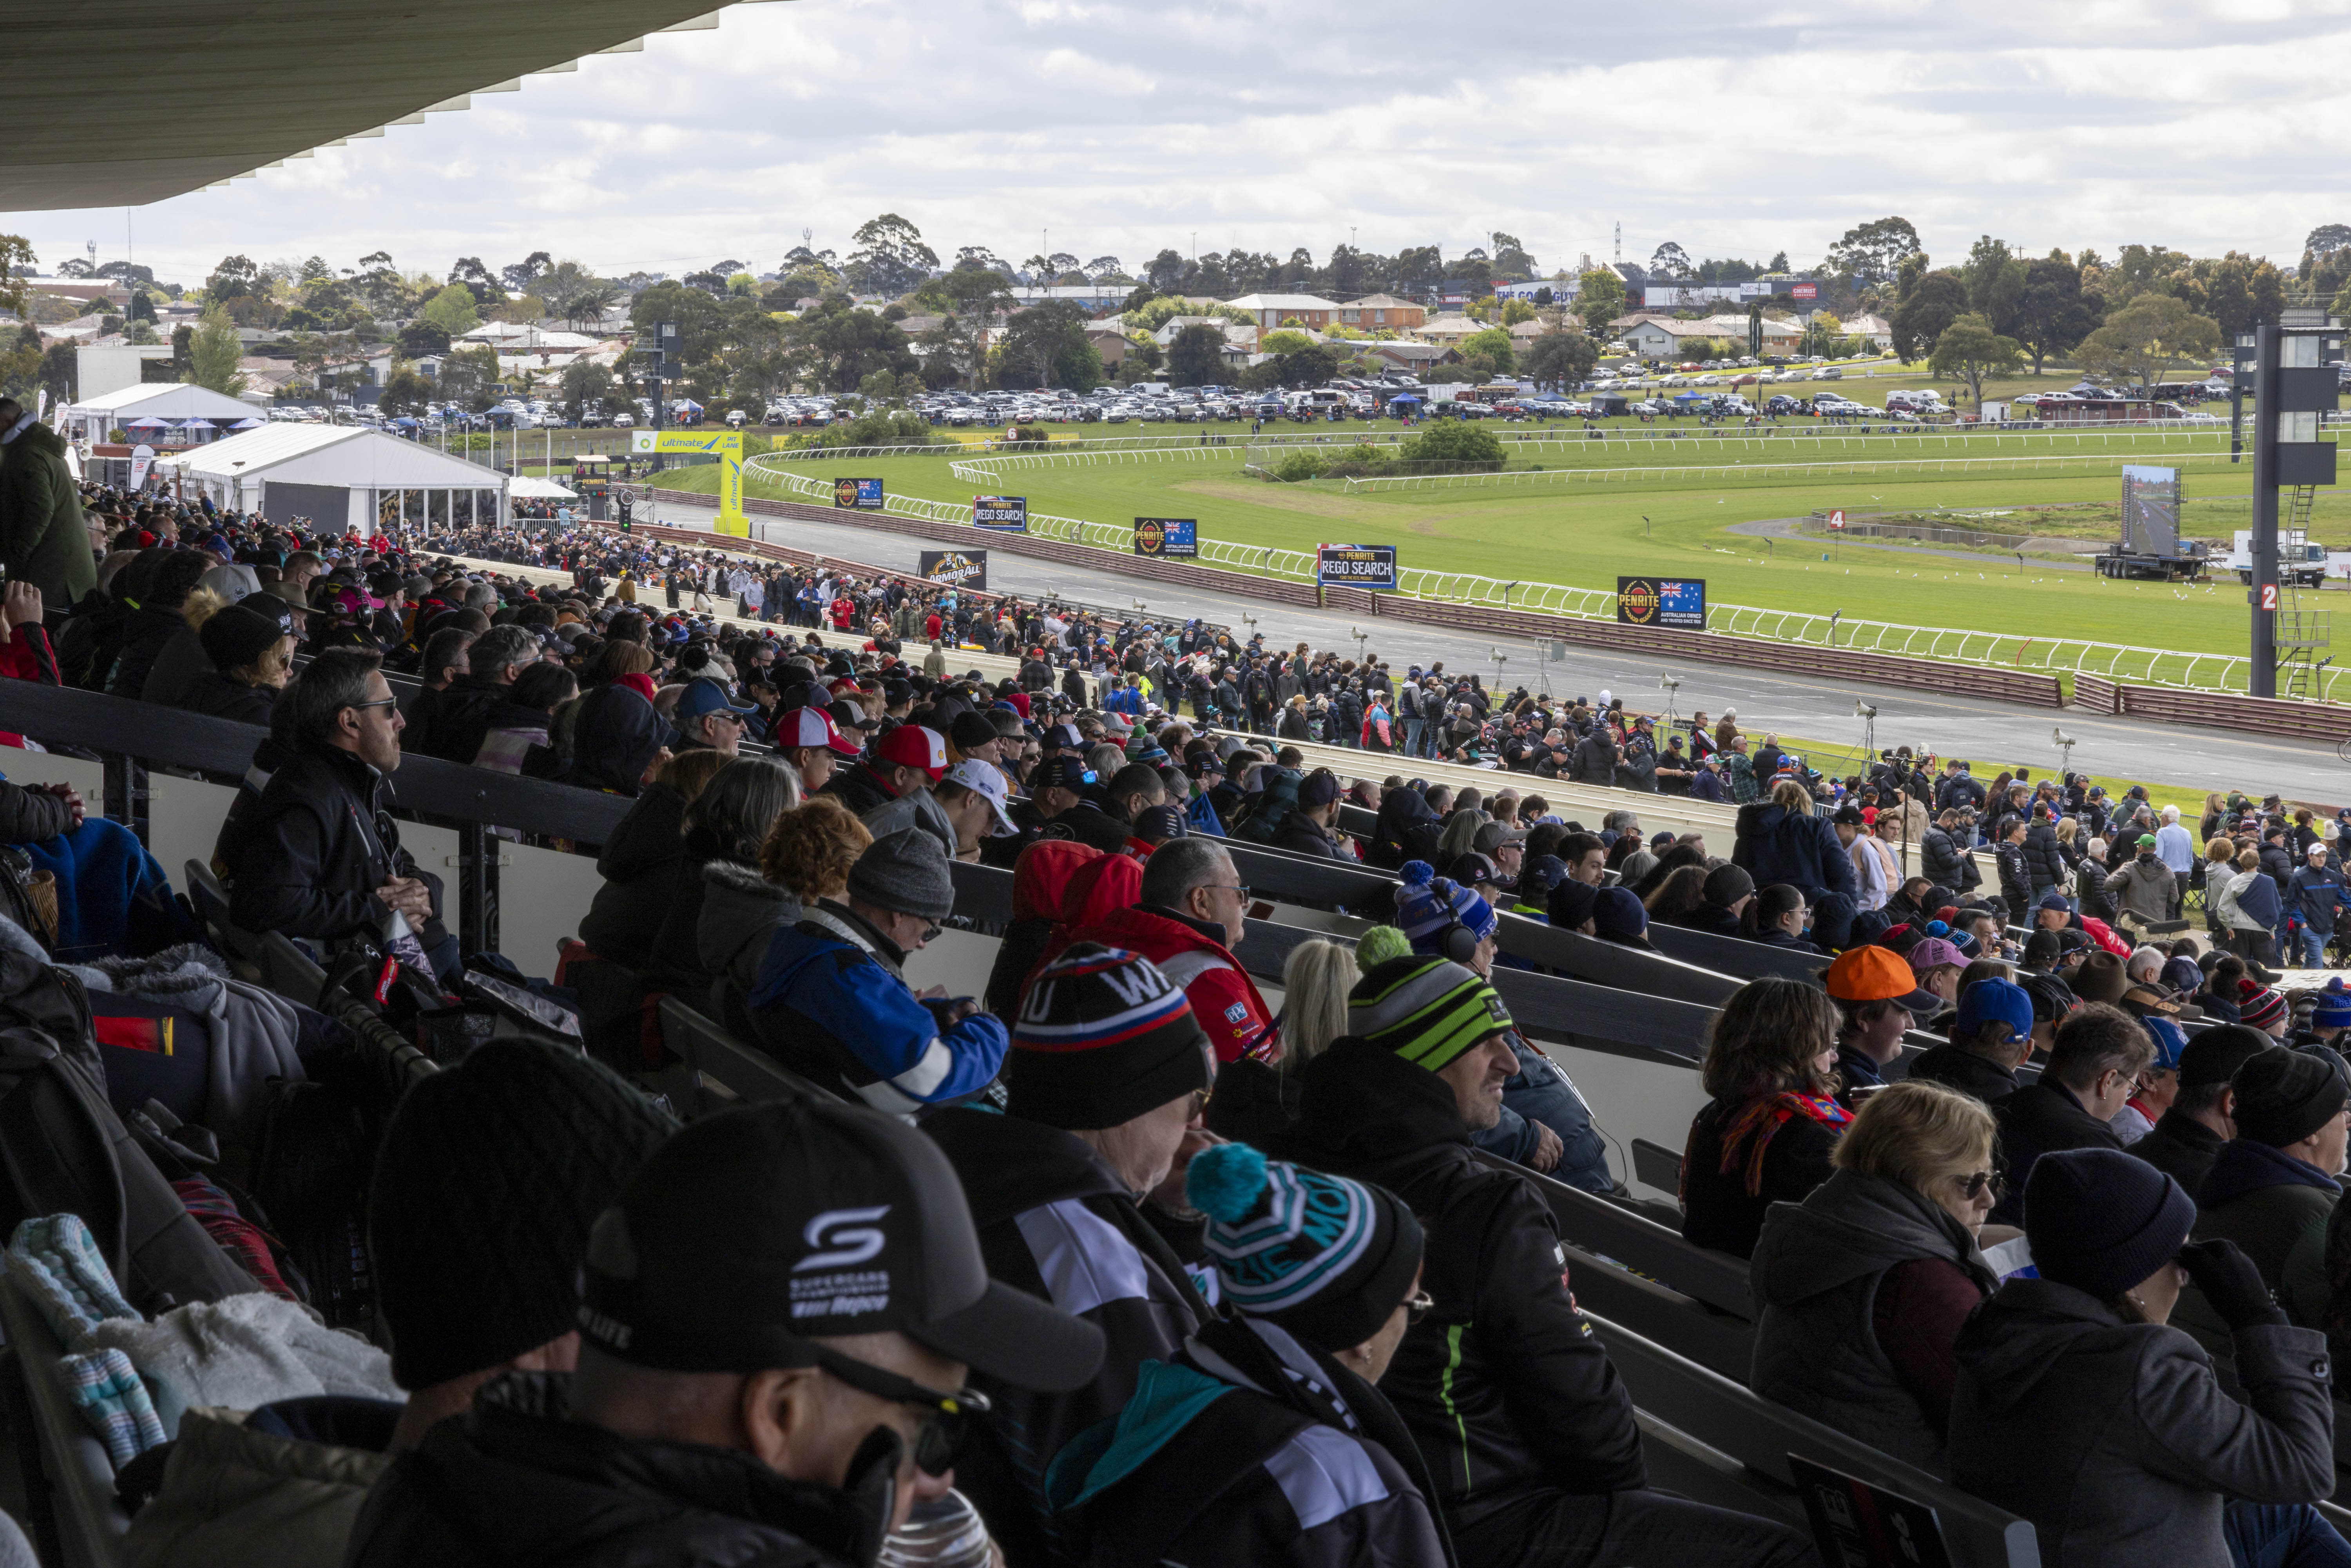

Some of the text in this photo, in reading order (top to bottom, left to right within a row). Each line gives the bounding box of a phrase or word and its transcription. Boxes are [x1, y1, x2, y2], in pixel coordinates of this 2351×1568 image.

[1008, 428, 1016, 438] 6
[662, 438, 703, 447] ultimate
[976, 509, 1022, 521] REGO SEARCH
[1831, 511, 1844, 527] 4
[1135, 531, 1165, 541] PENRITE
[1346, 552, 1375, 560] PENRITE
[1322, 560, 1391, 576] REGO SEARCH
[1619, 594, 1659, 608] PENRITE
[2263, 586, 2275, 608] 2
[279, 616, 291, 625] NED
[1227, 1005, 1245, 1020] PPG
[790, 1271, 889, 1289] SUPERCARS
